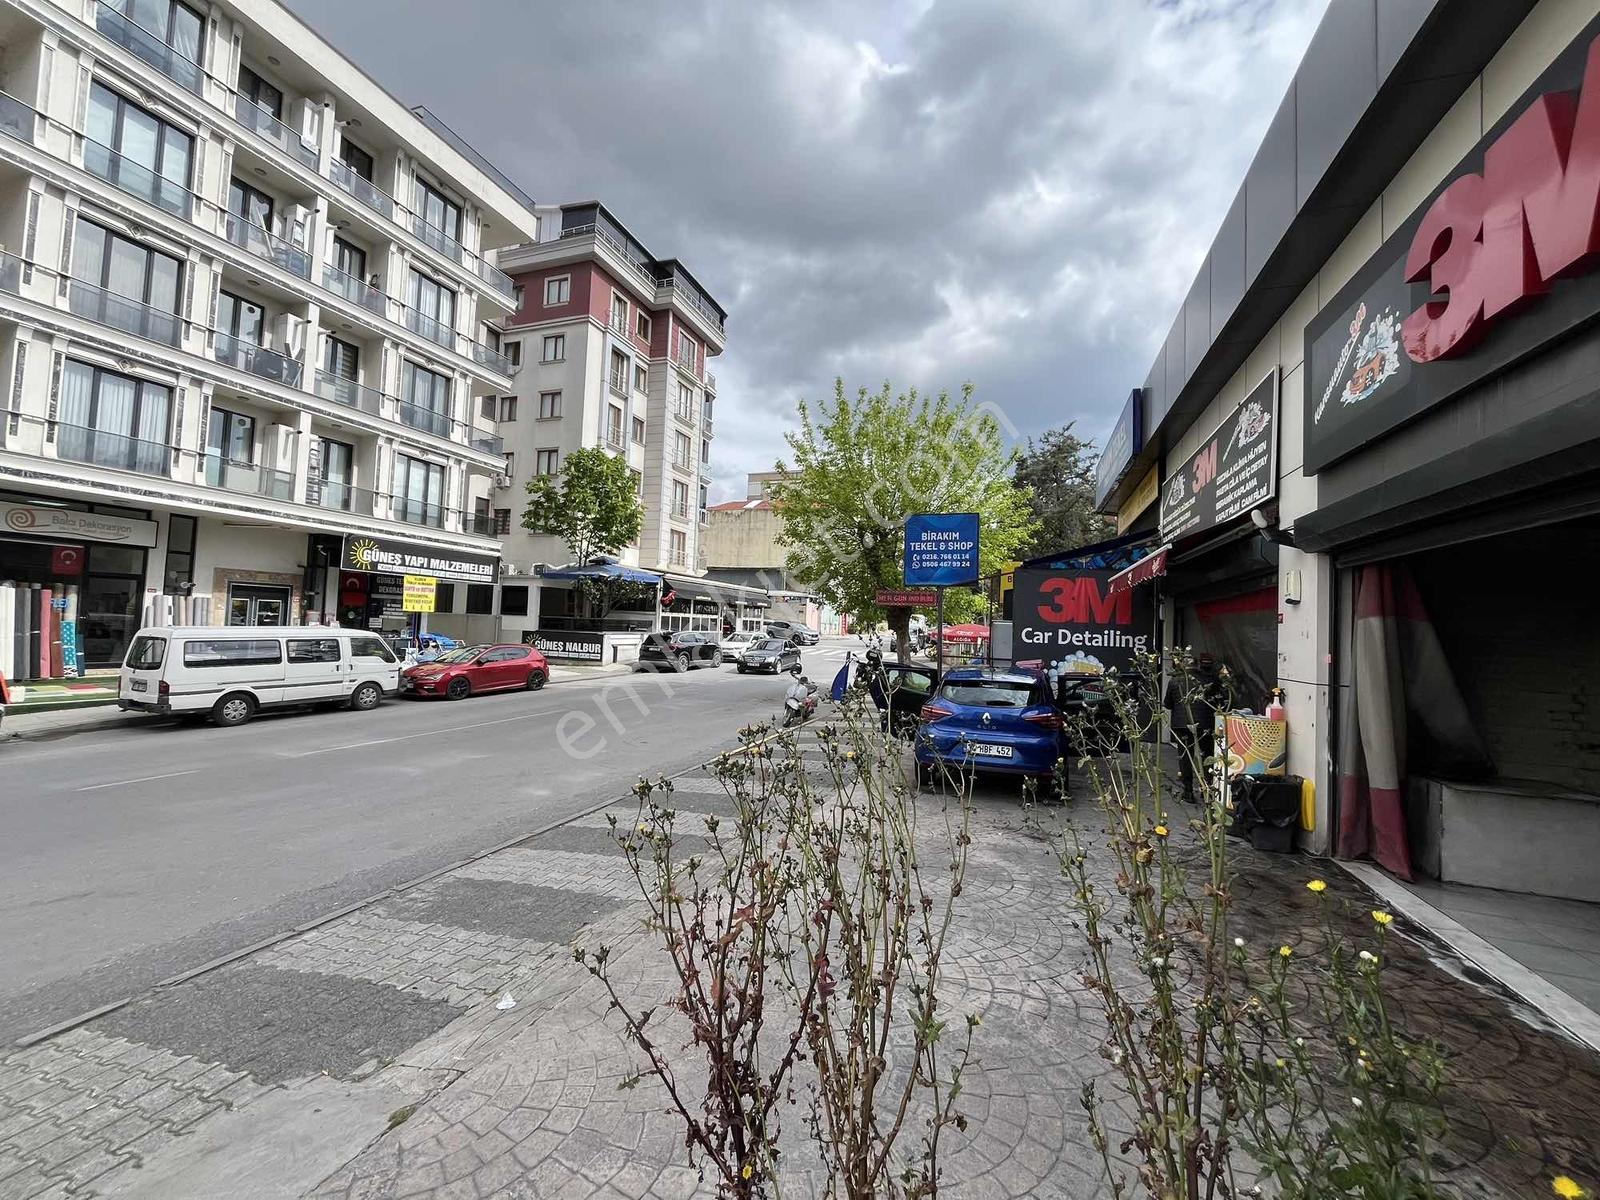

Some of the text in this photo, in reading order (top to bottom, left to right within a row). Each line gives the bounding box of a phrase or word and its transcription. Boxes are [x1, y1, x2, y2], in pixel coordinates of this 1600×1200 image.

[1401, 32, 1600, 363] 3M
[1192, 438, 1218, 493] 3M
[910, 542, 938, 551] TEKEL
[948, 541, 974, 551] SHOP
[921, 531, 960, 541] BİRAKIM
[363, 548, 402, 566] GÜNEŞ
[404, 554, 428, 569] YAPI
[430, 559, 493, 576] MALZEMELERİ
[1037, 576, 1132, 625] 3M
[535, 638, 601, 654] GÜNEŞ NALBUR
[1021, 627, 1148, 653] Car Detailing
[996, 746, 1011, 756] 452
